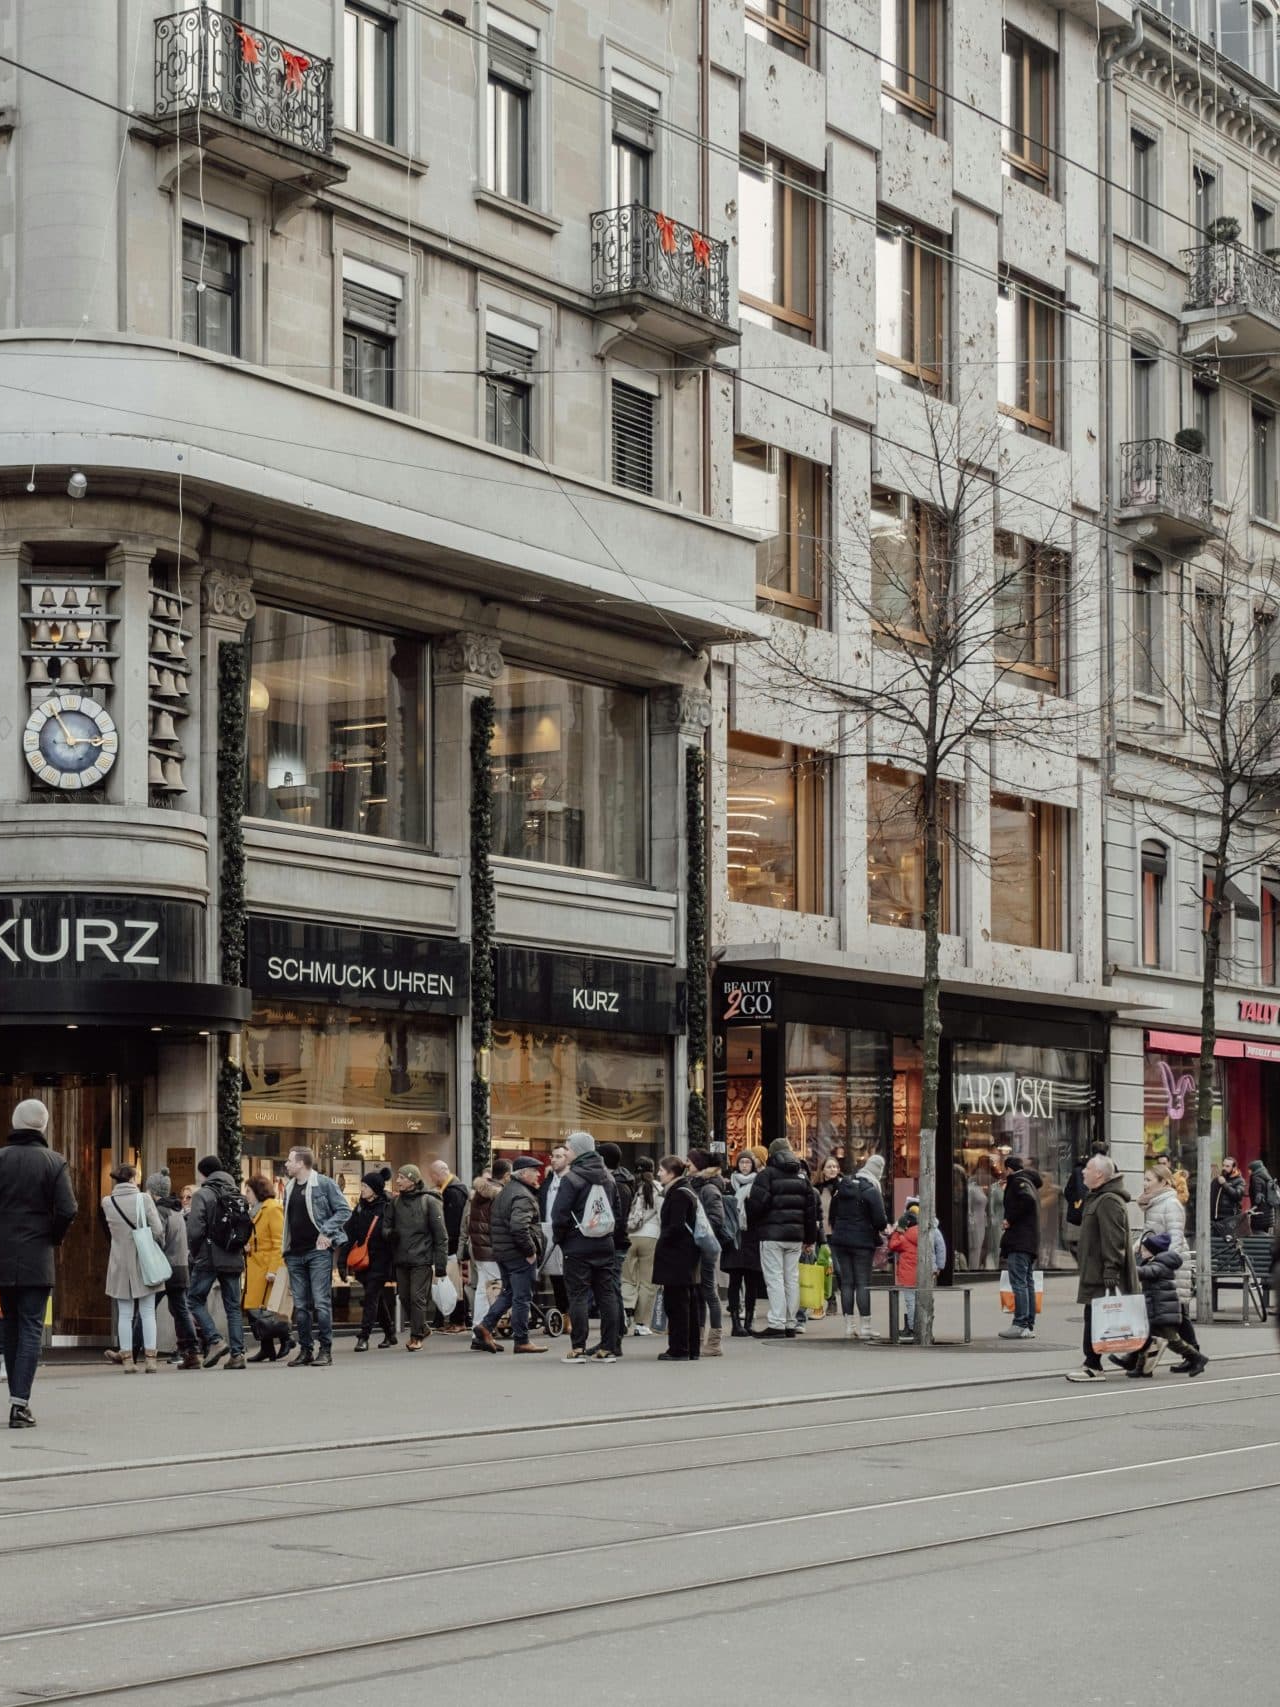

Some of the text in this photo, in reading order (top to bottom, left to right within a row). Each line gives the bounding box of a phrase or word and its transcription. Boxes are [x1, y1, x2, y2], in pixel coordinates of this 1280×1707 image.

[267, 956, 454, 997] SCHMUCK UHREN
[724, 980, 772, 994] BEAUTY
[572, 988, 619, 1012] KURZ
[723, 989, 772, 1020] 2GO
[1239, 1000, 1278, 1024] TALLY
